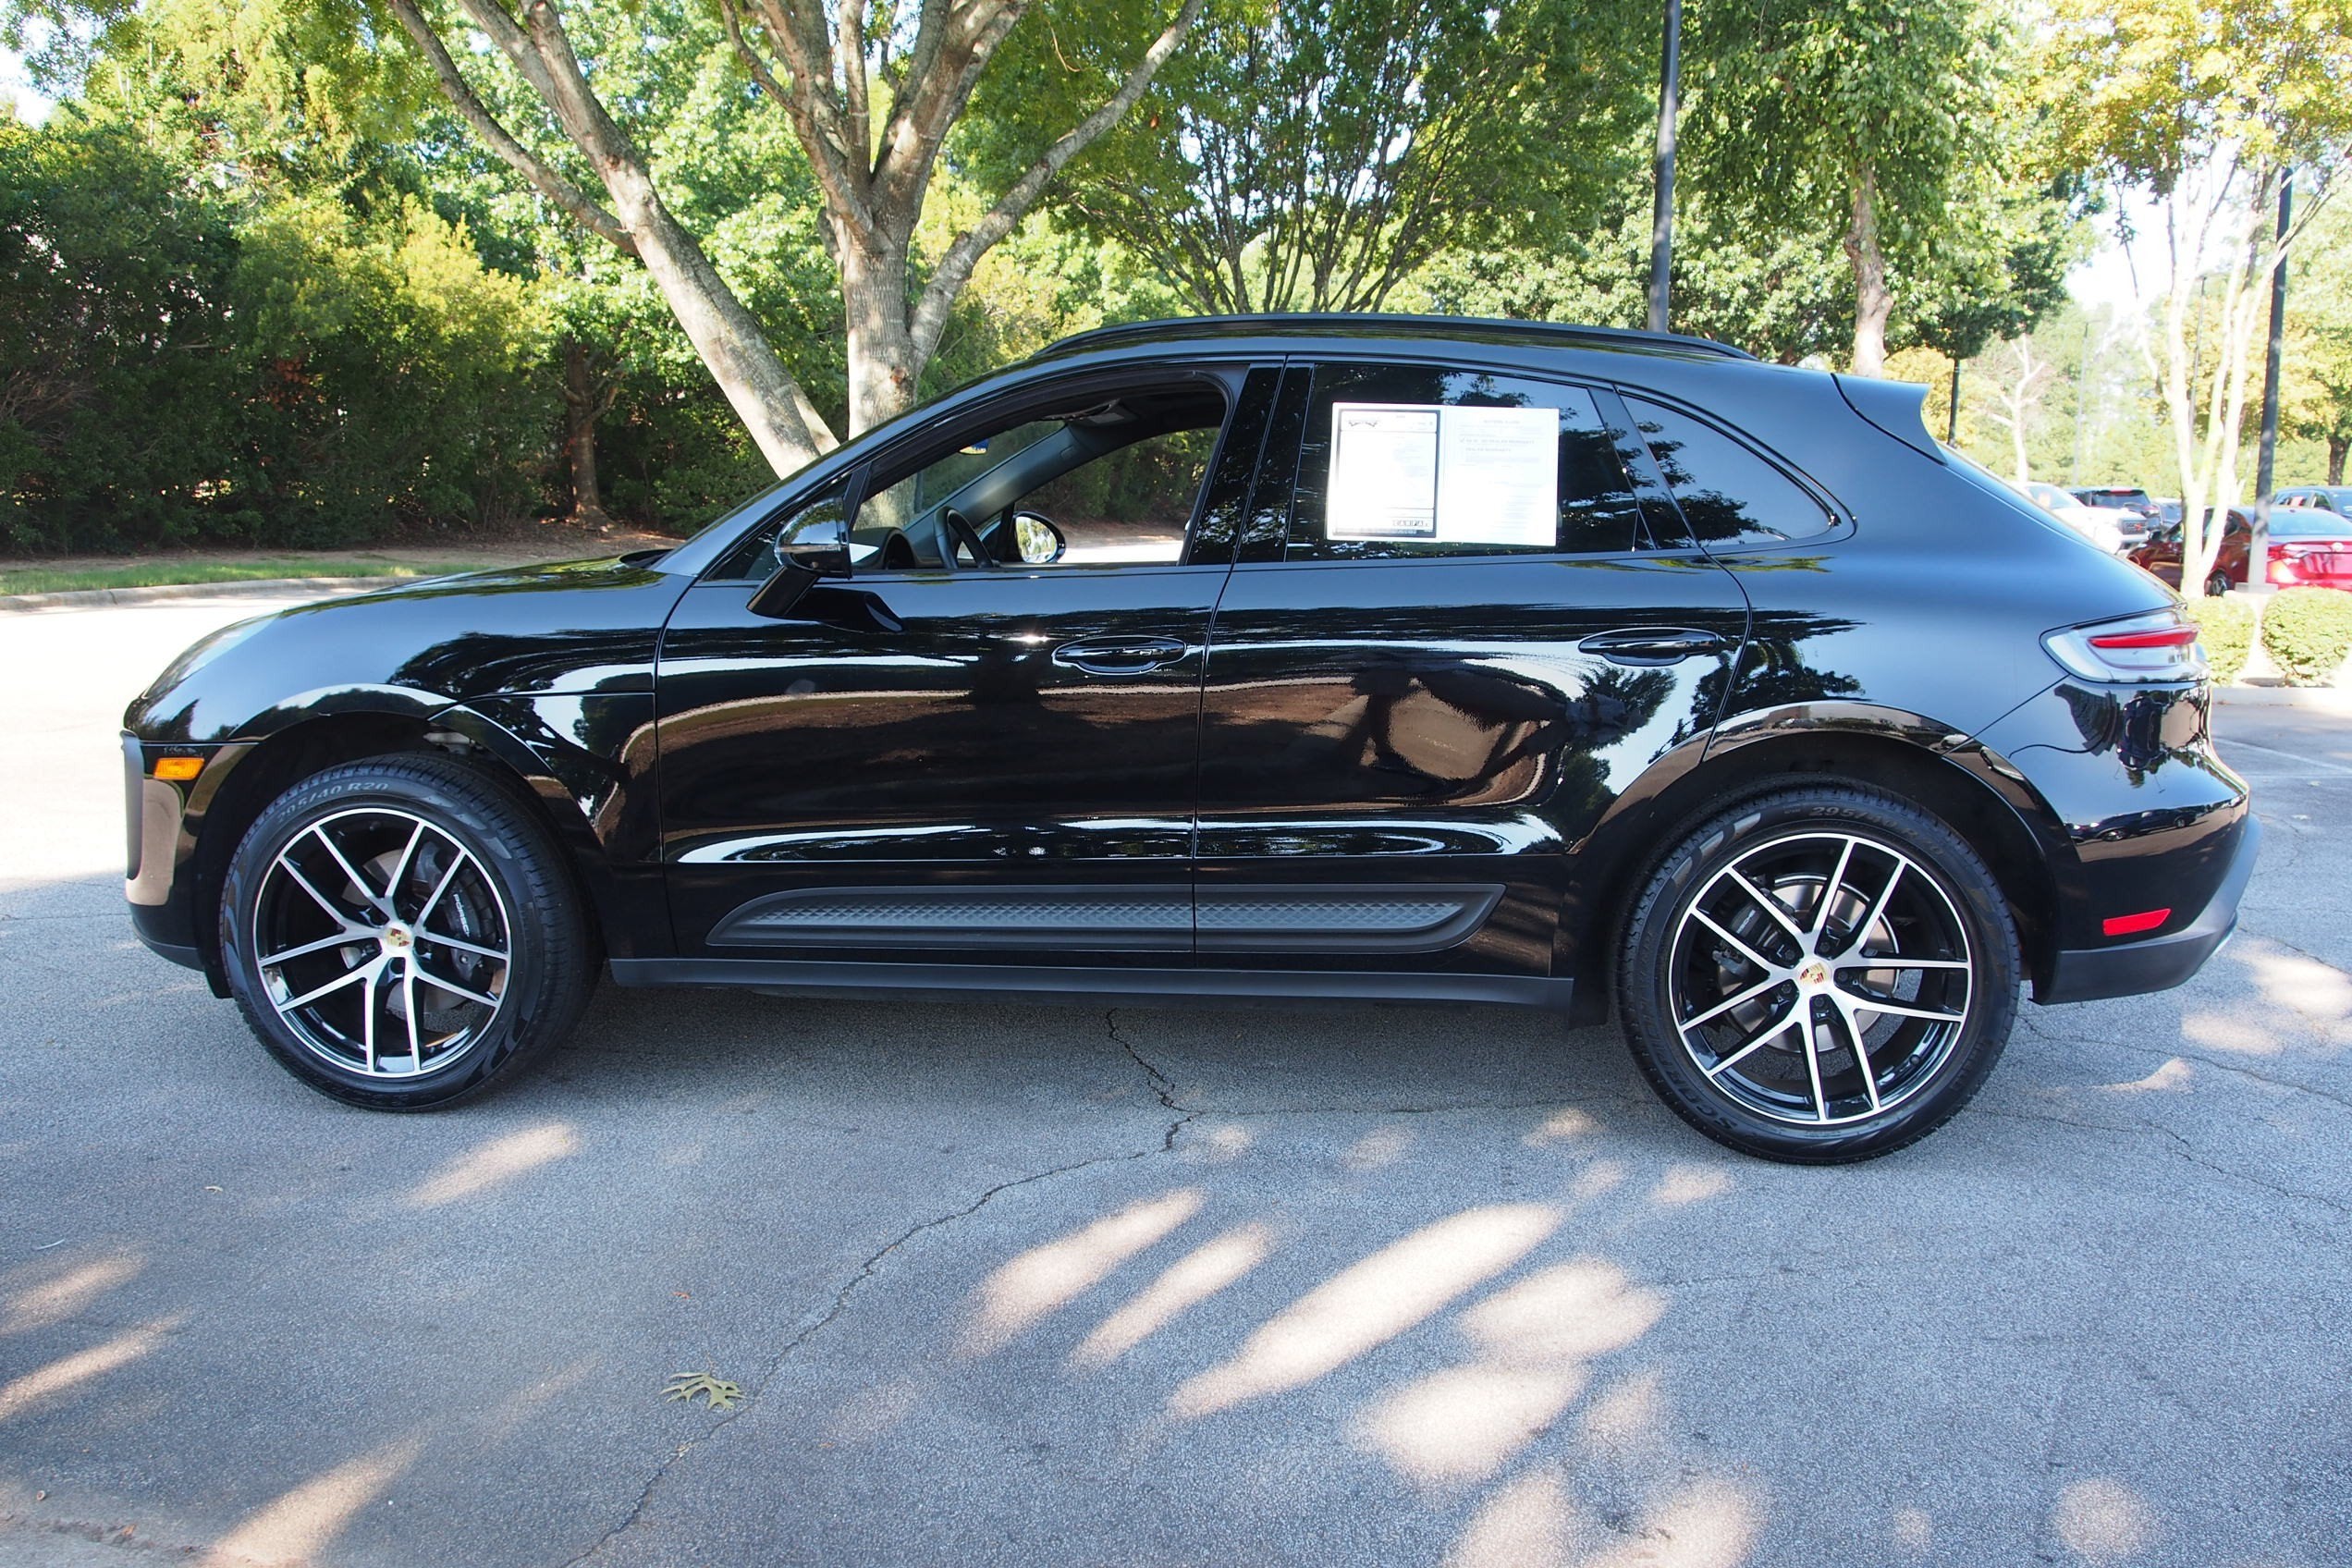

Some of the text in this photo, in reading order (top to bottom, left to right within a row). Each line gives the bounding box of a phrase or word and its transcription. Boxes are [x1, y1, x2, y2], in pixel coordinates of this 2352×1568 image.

[348, 782, 389, 790] R20
[1808, 806, 1899, 828] 295/40
[453, 893, 470, 937] PORSC
